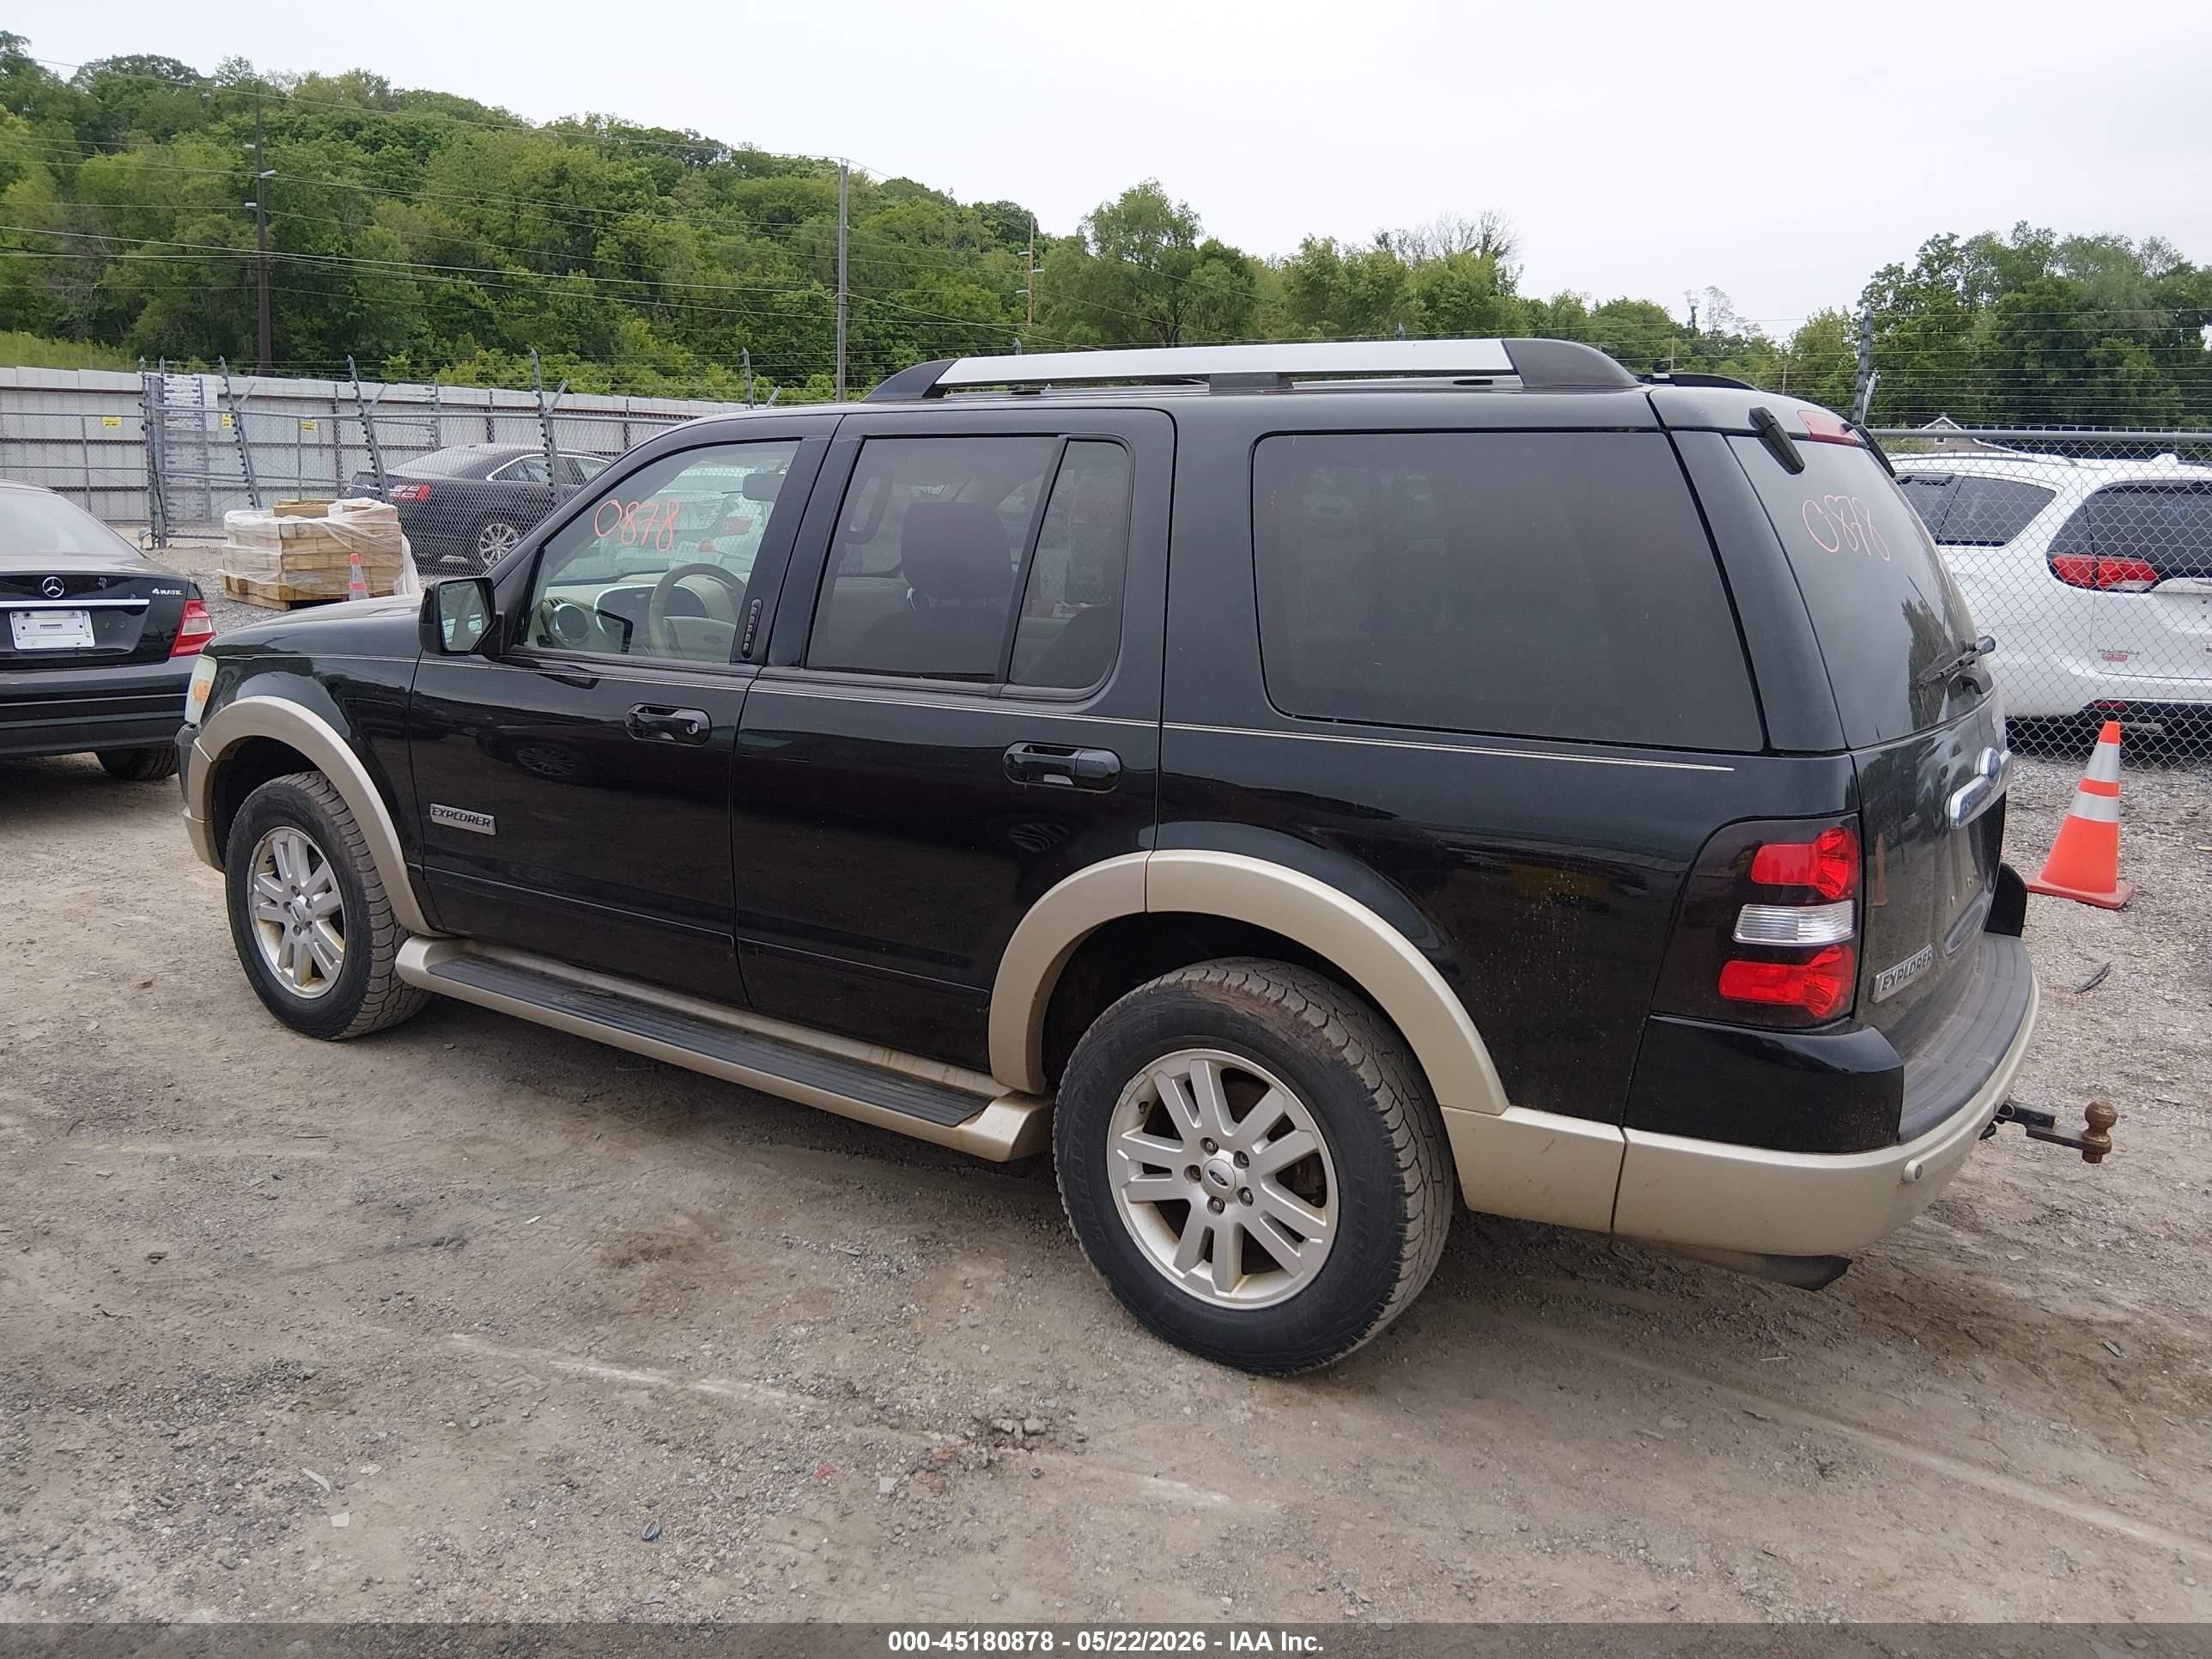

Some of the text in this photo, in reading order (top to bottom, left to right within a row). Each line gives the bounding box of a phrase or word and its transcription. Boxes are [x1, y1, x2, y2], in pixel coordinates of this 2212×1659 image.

[594, 499, 680, 552] 0878
[1802, 494, 1891, 562] 0878
[431, 806, 491, 828] EXPLORER
[1879, 948, 1933, 994] EXPLORER
